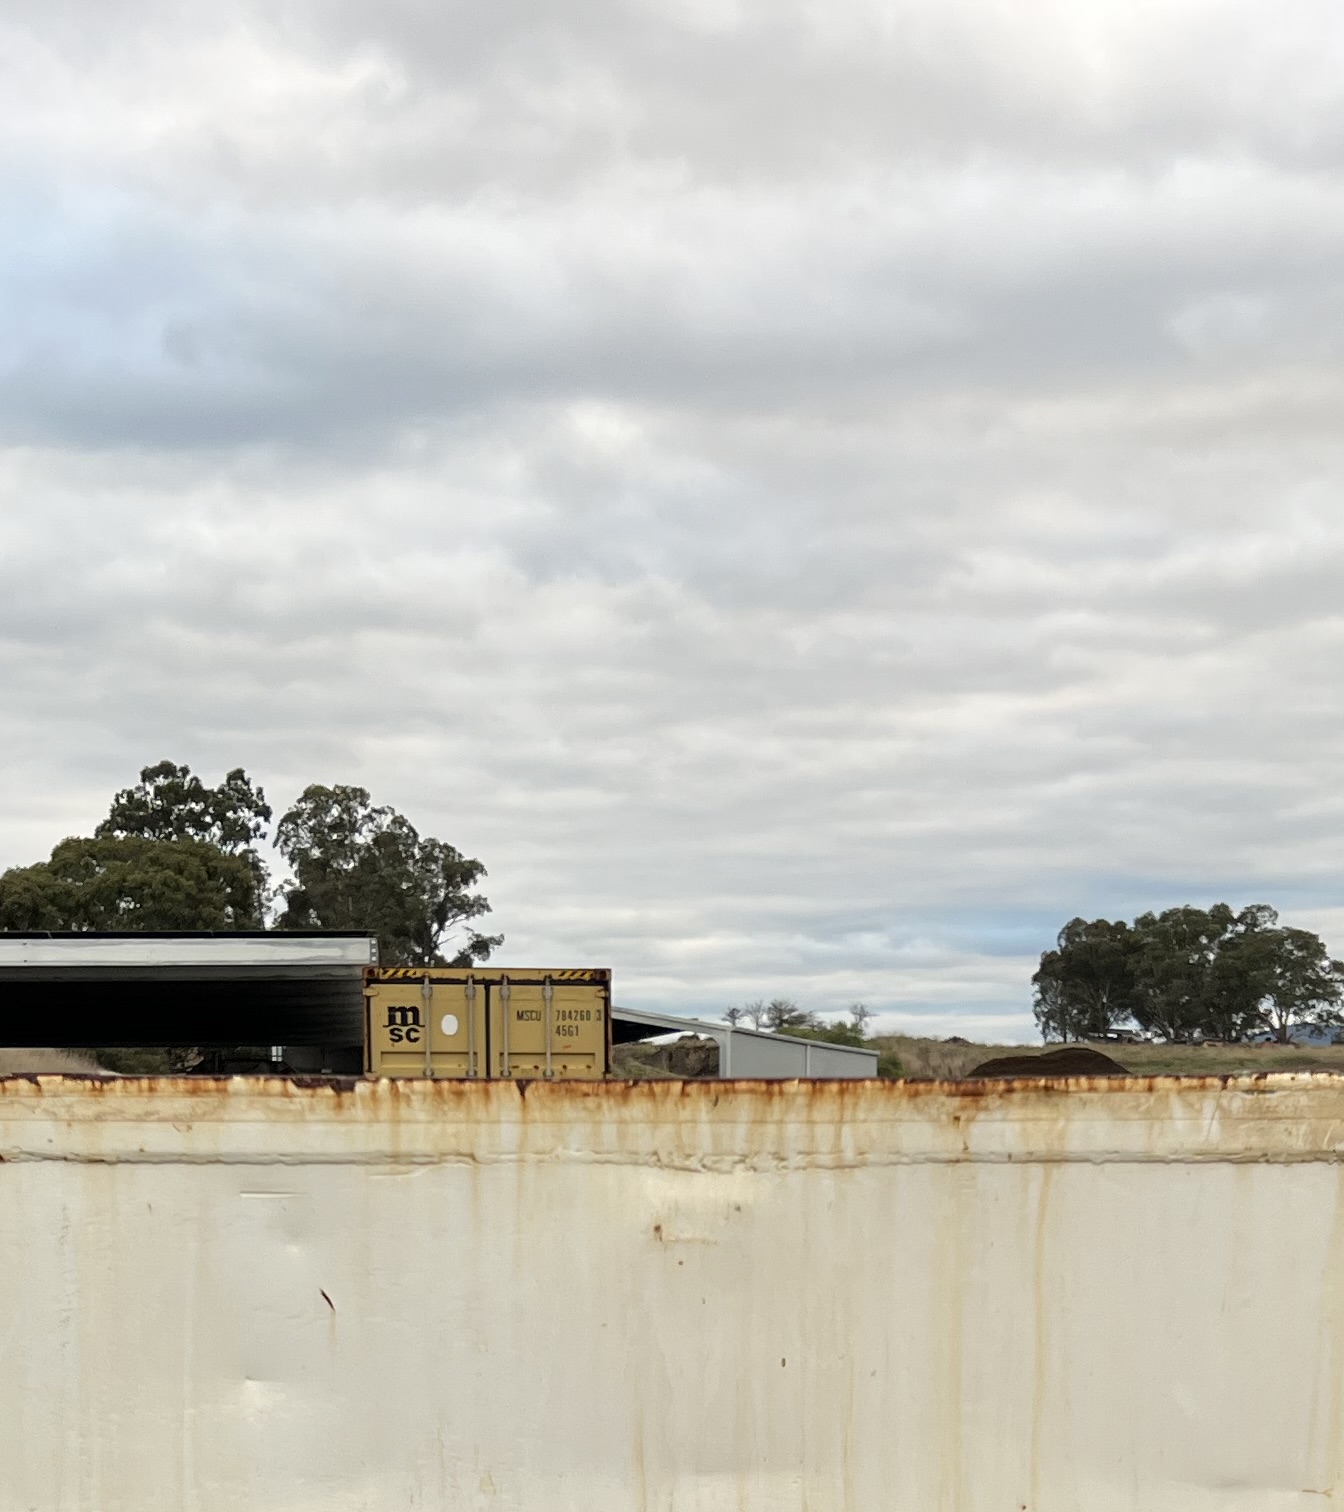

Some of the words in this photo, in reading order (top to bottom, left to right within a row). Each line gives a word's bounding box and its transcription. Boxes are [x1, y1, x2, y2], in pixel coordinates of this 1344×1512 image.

[516, 1010, 542, 1022] MSCU
[555, 1010, 591, 1022] 784260
[555, 1024, 579, 1037] 45G1
